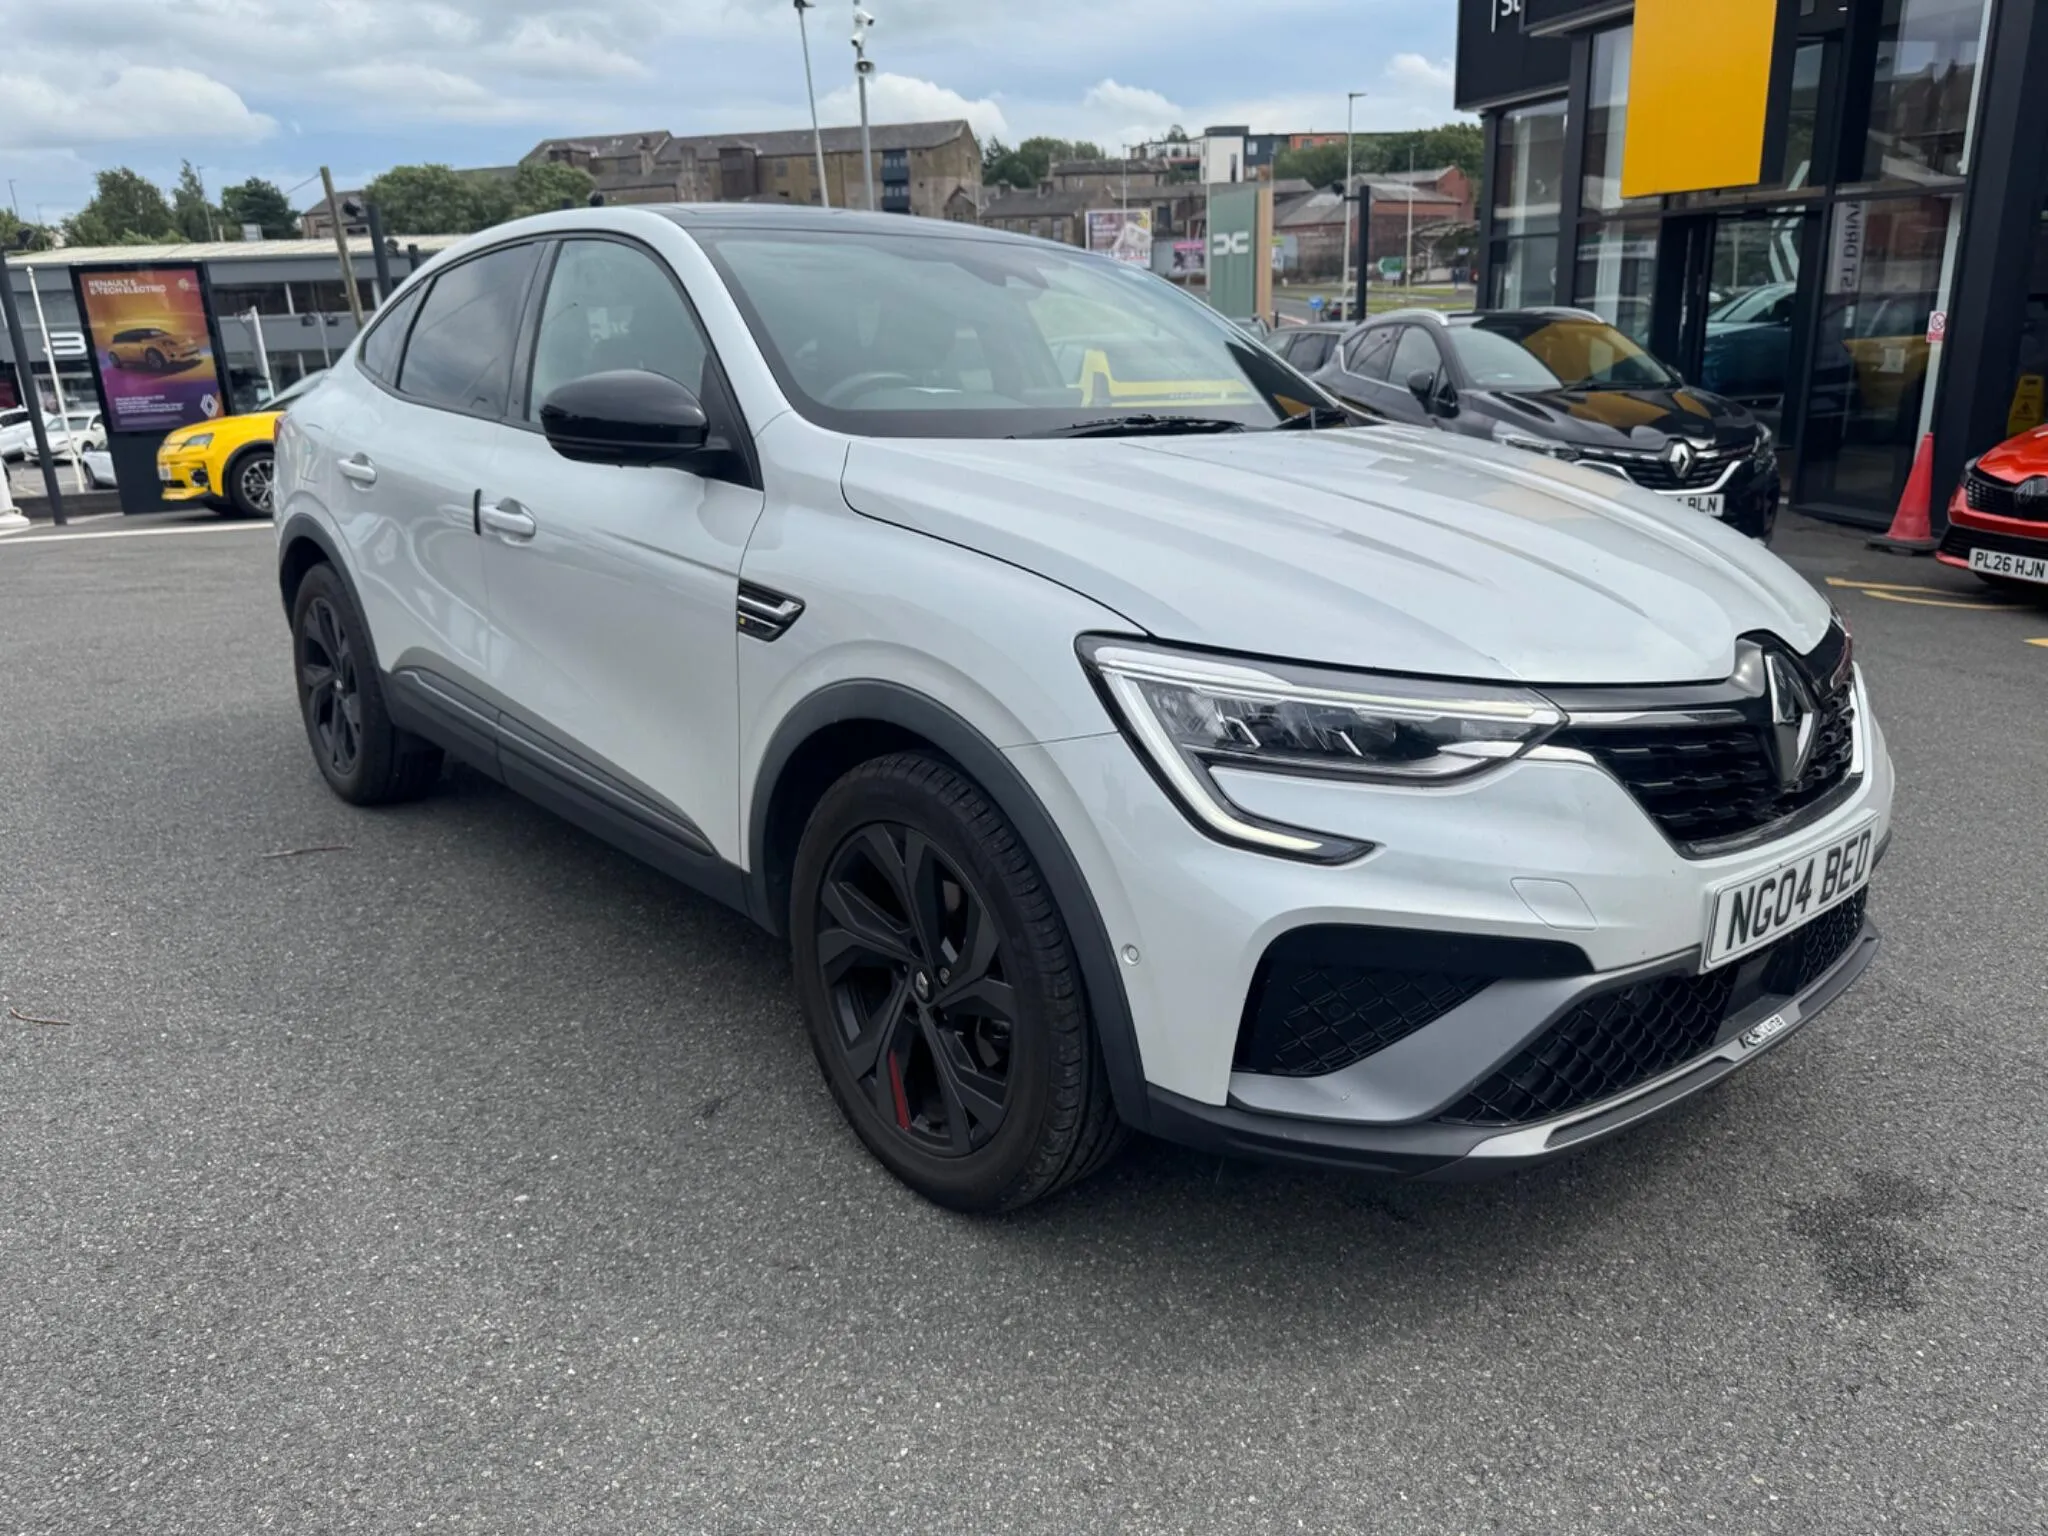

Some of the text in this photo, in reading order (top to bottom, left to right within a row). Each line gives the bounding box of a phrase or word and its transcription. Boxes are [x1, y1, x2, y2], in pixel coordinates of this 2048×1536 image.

[1975, 551, 2046, 579] PL26 HJN
[1726, 828, 1872, 950] NG04 BED
